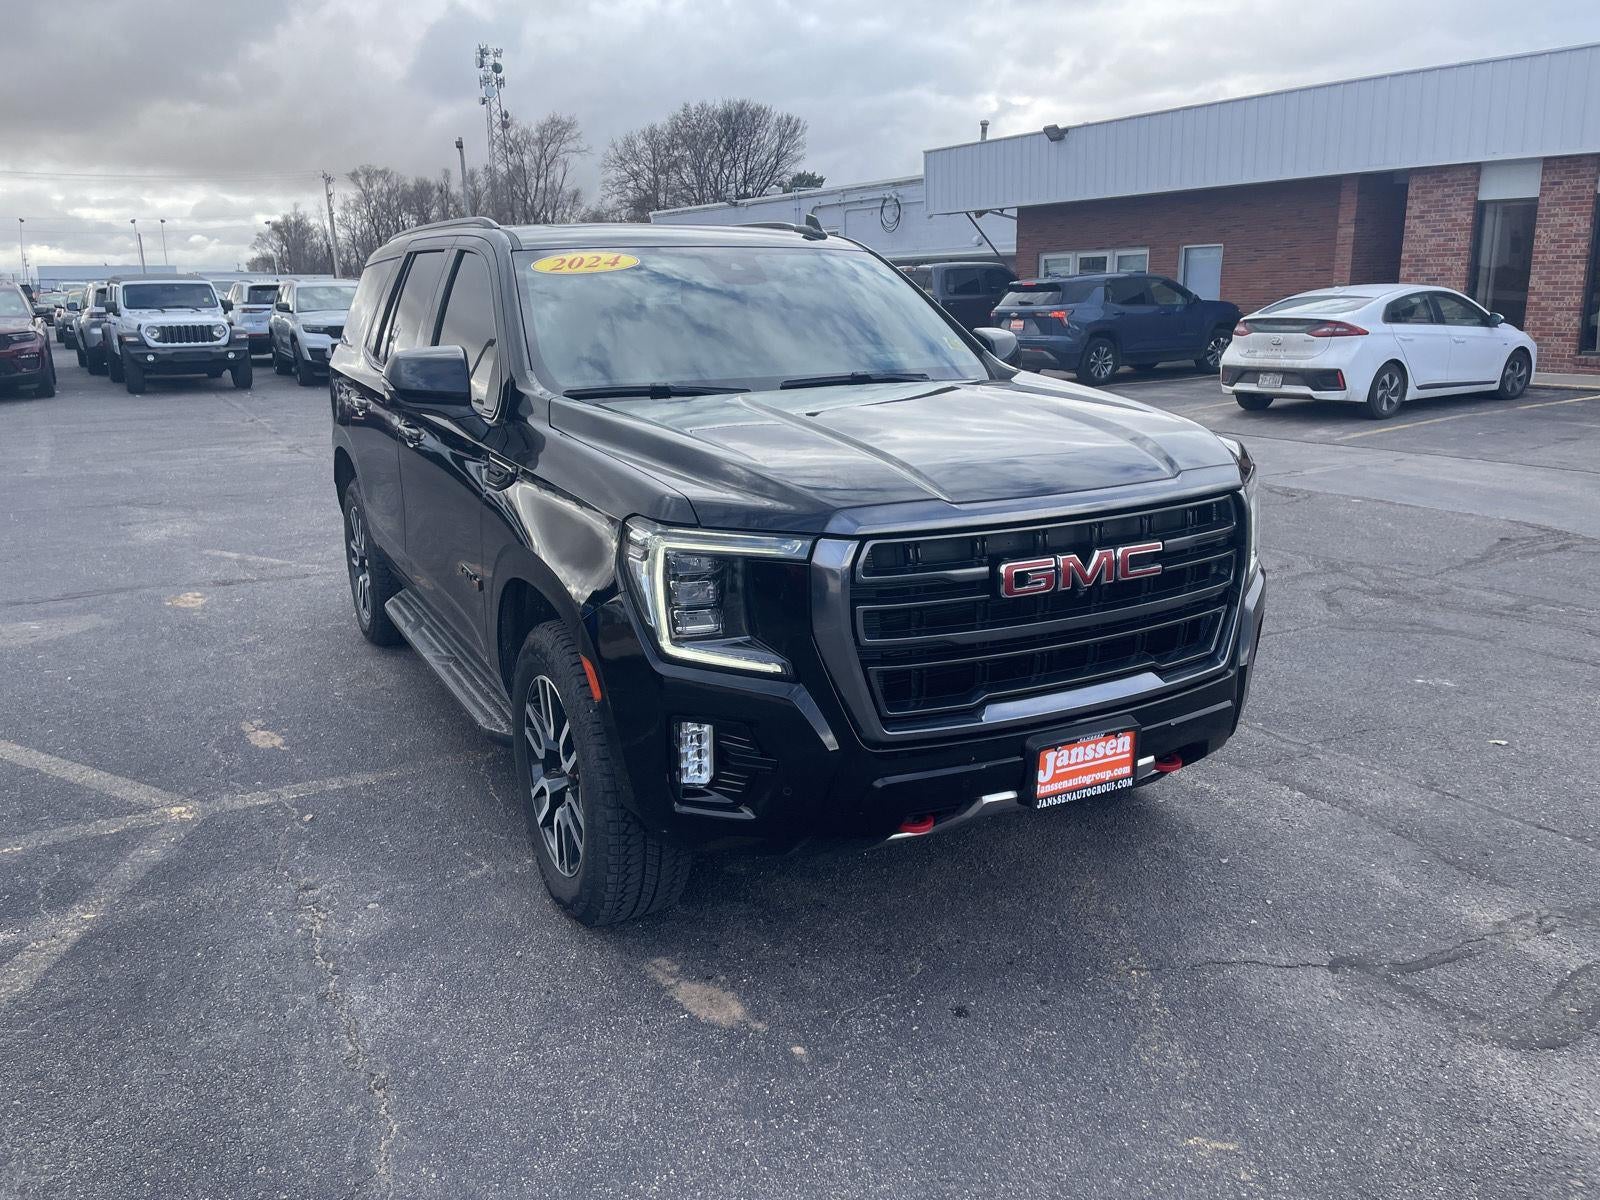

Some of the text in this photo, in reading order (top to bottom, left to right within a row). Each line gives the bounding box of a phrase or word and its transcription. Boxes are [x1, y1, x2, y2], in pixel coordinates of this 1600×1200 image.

[549, 255, 622, 272] 2024
[1000, 541, 1163, 599] GMC
[1038, 734, 1131, 783] Janssen
[1037, 777, 1134, 809] JANSSENAUTOGROUP.COM
